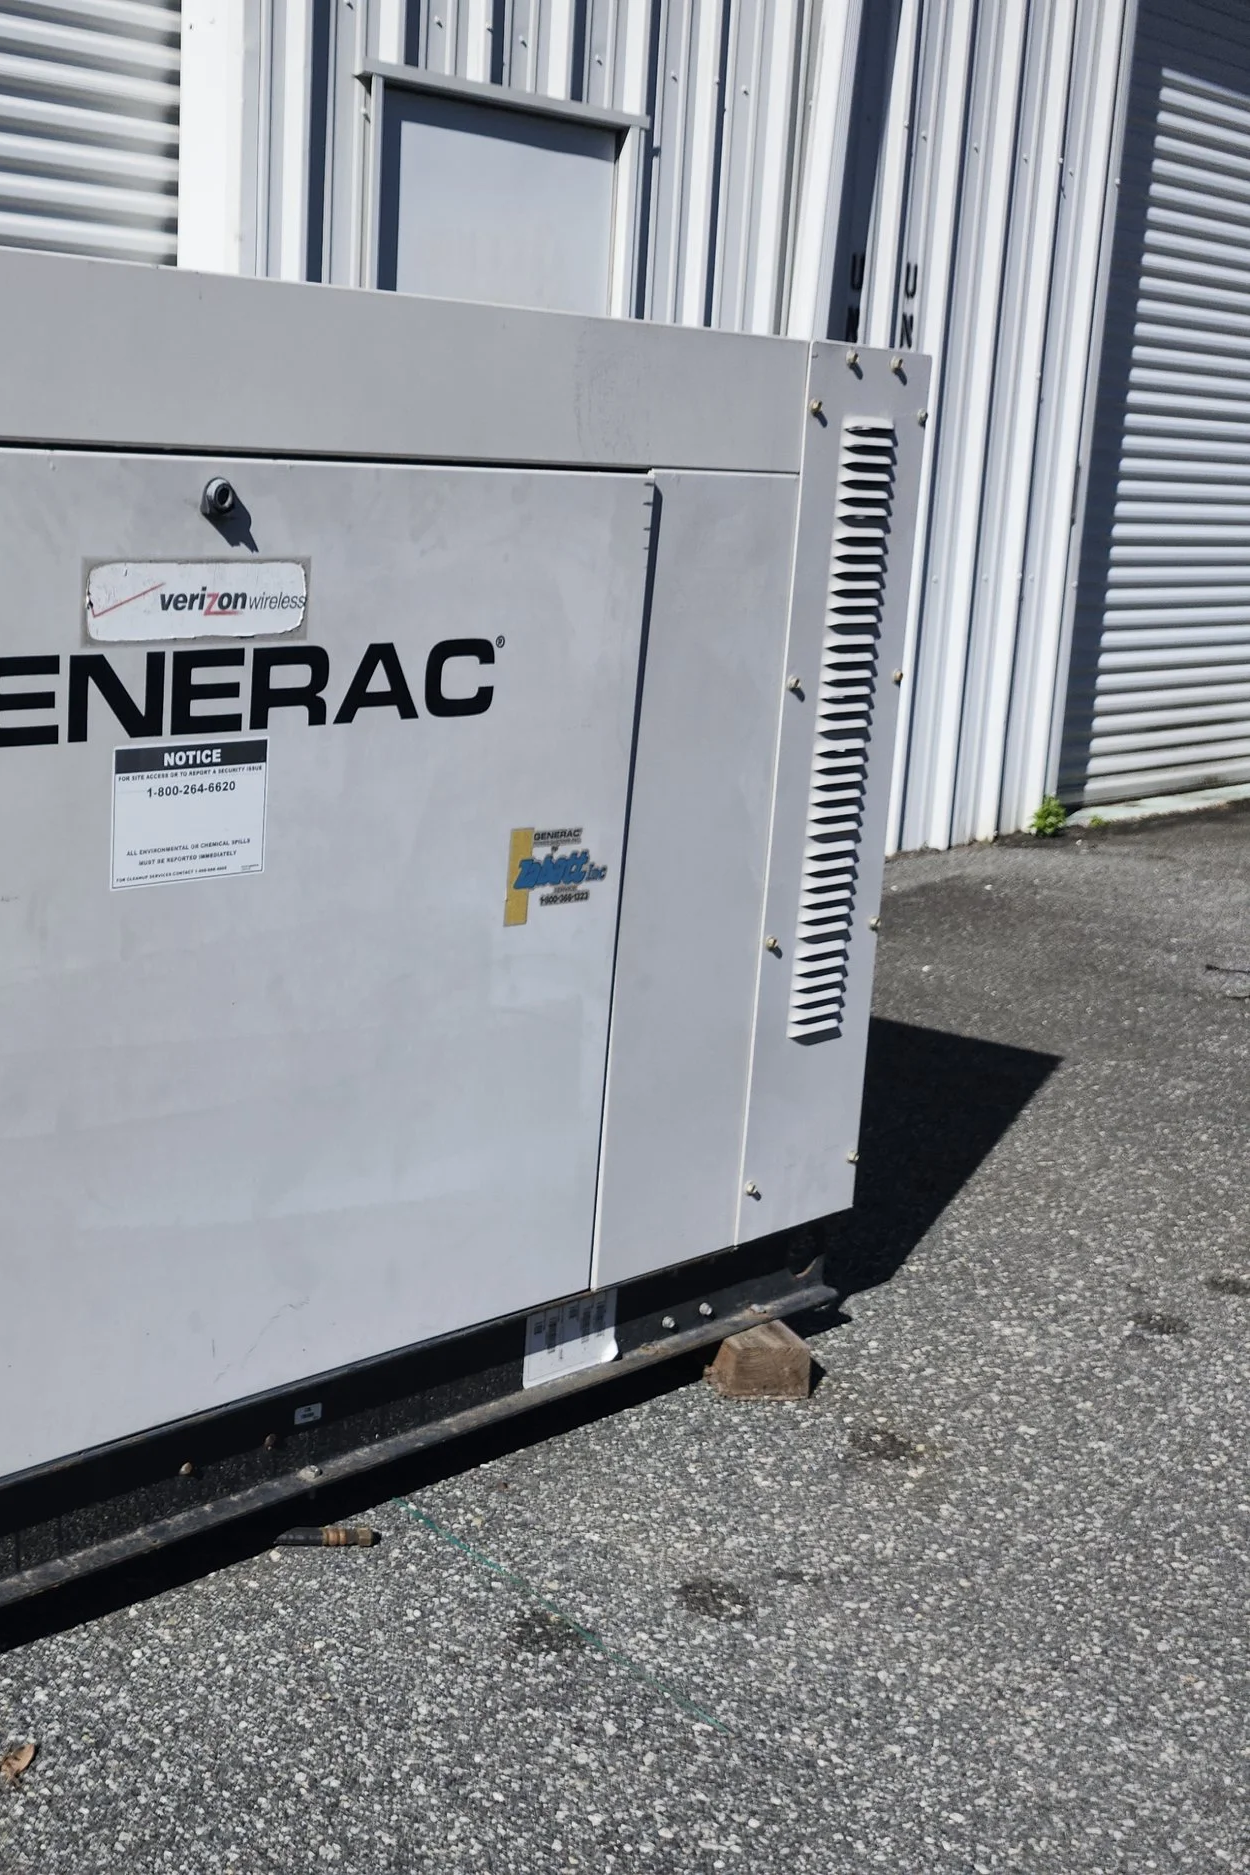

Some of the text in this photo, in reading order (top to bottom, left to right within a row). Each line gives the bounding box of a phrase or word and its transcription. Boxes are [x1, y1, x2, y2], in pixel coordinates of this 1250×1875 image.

[160, 586, 306, 615] verizon wireless
[163, 748, 222, 767] NOTICE
[146, 772, 168, 780] ACCESS
[218, 766, 245, 774] SECURITY
[147, 781, 236, 798] 1-800-264-6620
[533, 828, 581, 841] GENERAC
[139, 844, 189, 855] ENVIRONMENTAL
[200, 840, 230, 848] CHEMICAL
[232, 837, 251, 845] SPILLS
[166, 854, 197, 863] REPORTED
[199, 850, 237, 859] IMMEDIATELY
